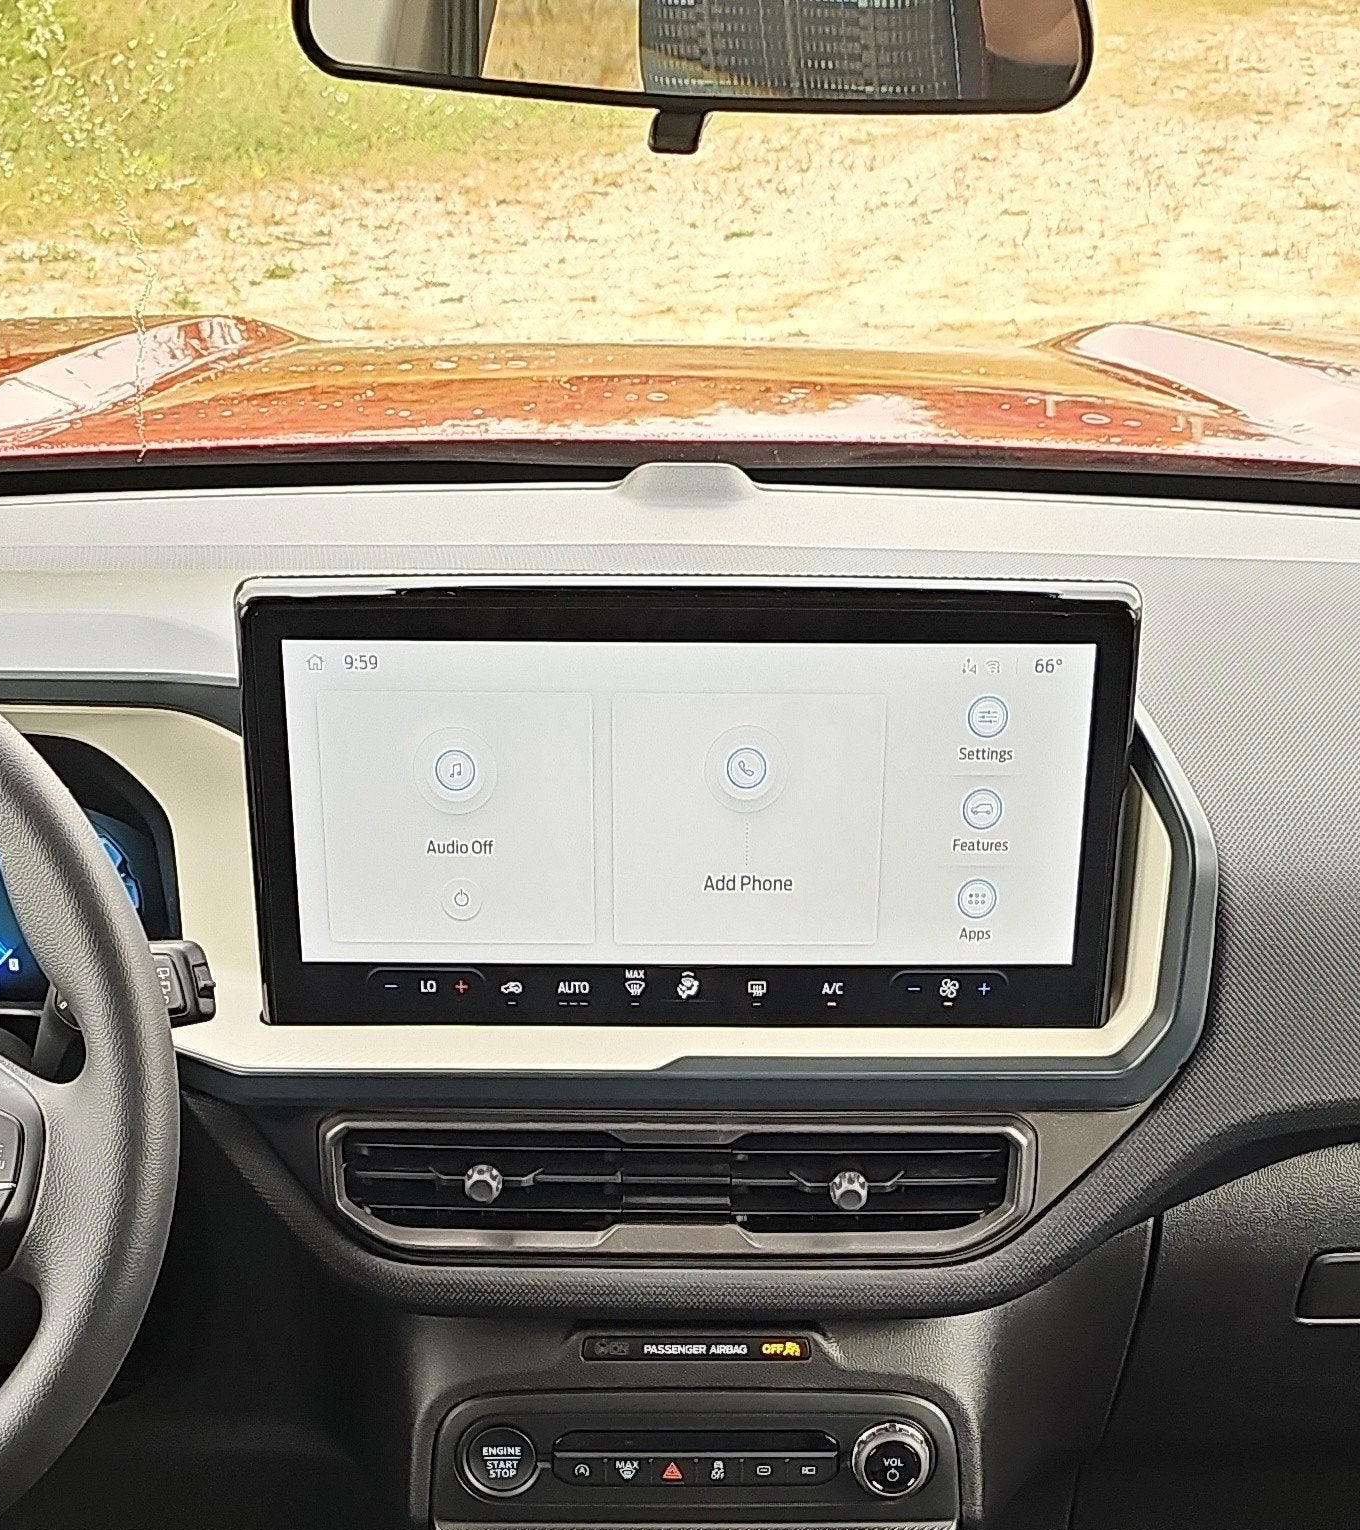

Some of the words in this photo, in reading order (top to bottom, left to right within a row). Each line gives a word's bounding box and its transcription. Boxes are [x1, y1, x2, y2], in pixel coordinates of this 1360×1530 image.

[343, 653, 379, 672] 9:59
[1034, 656, 1064, 675] 66°
[957, 746, 1014, 764] Settings
[426, 838, 468, 857] Audio
[471, 838, 494, 857] Off
[951, 837, 1009, 854] Features
[702, 874, 734, 892] Add
[739, 874, 793, 893] Phone
[958, 925, 992, 943] Apps
[625, 969, 645, 979] MAX
[420, 981, 437, 995] LO
[557, 981, 589, 995] AUTO
[821, 981, 843, 996] A/C
[643, 1343, 706, 1355] PASSENGER
[709, 1343, 748, 1356] AIRBAG
[762, 1343, 783, 1355] OFF
[482, 1445, 521, 1456] ENGINE
[486, 1460, 518, 1470] START
[615, 1460, 639, 1469] MAX
[883, 1457, 904, 1468] VOL
[488, 1469, 517, 1479] STOP
